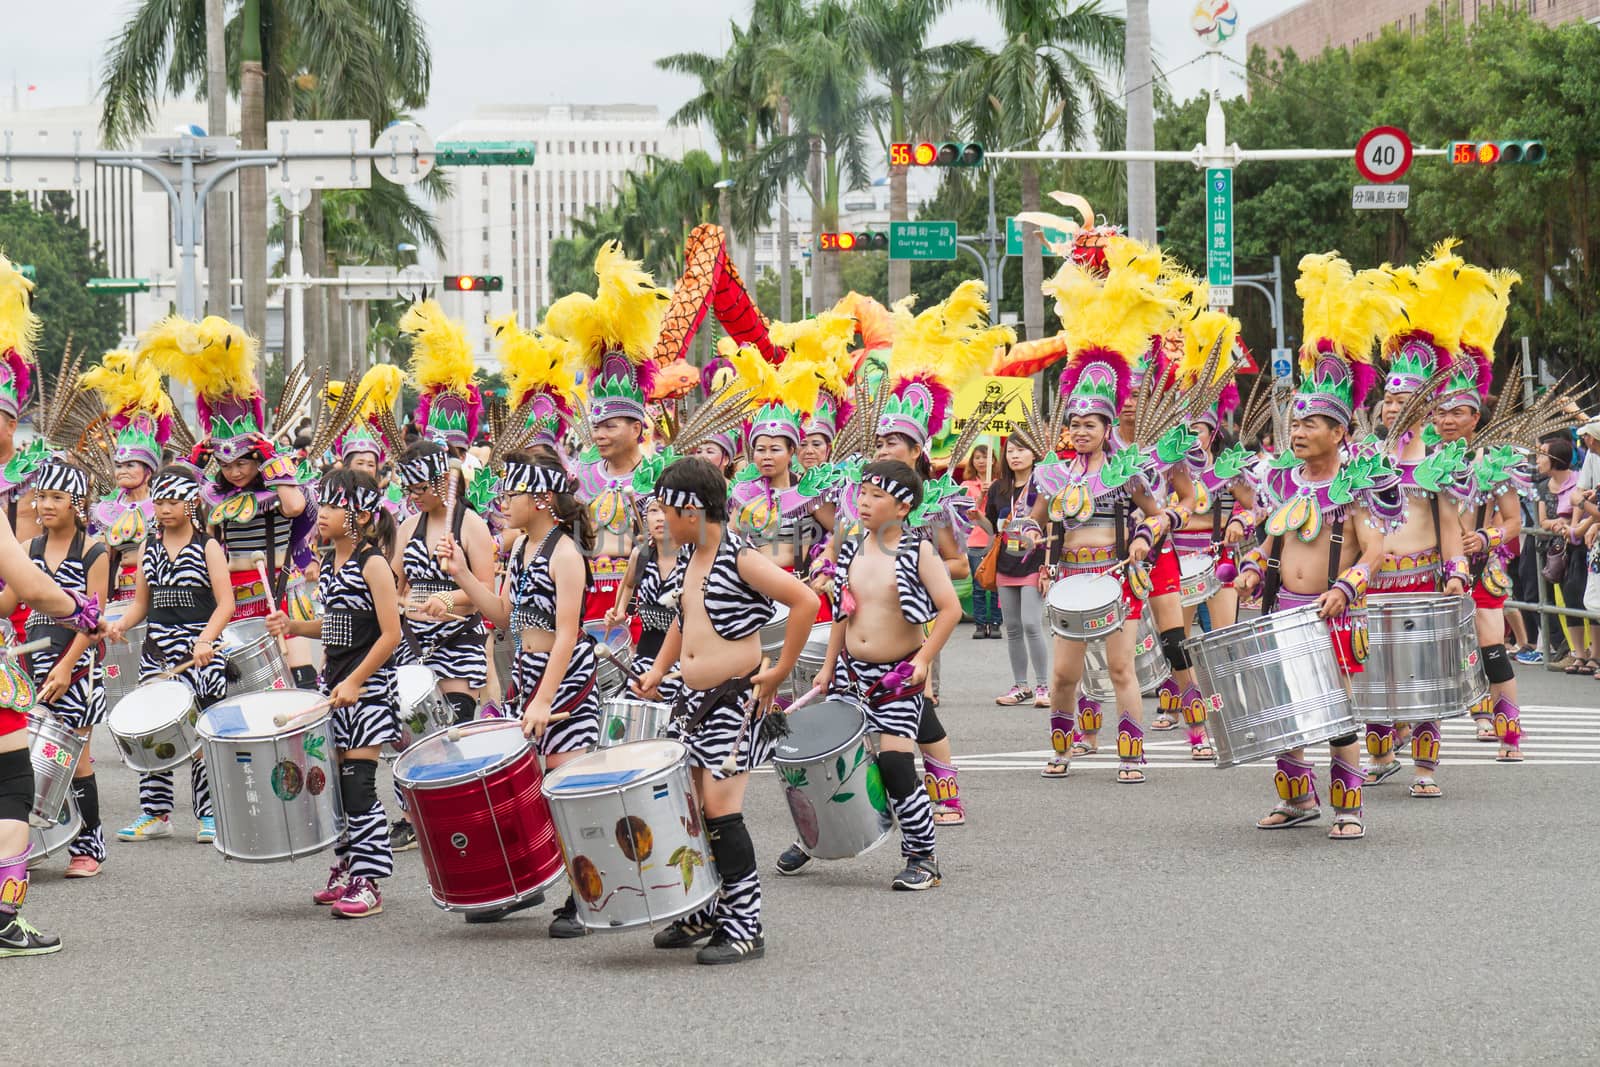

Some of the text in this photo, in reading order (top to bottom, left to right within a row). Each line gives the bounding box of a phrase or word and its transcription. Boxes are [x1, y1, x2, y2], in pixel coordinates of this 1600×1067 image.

[890, 145, 910, 165] 56
[1372, 145, 1395, 166] 40
[1354, 190, 1407, 204] 分隔島右側
[1213, 194, 1226, 248] 中山南路
[821, 233, 836, 249] 51
[987, 385, 1001, 394] 32
